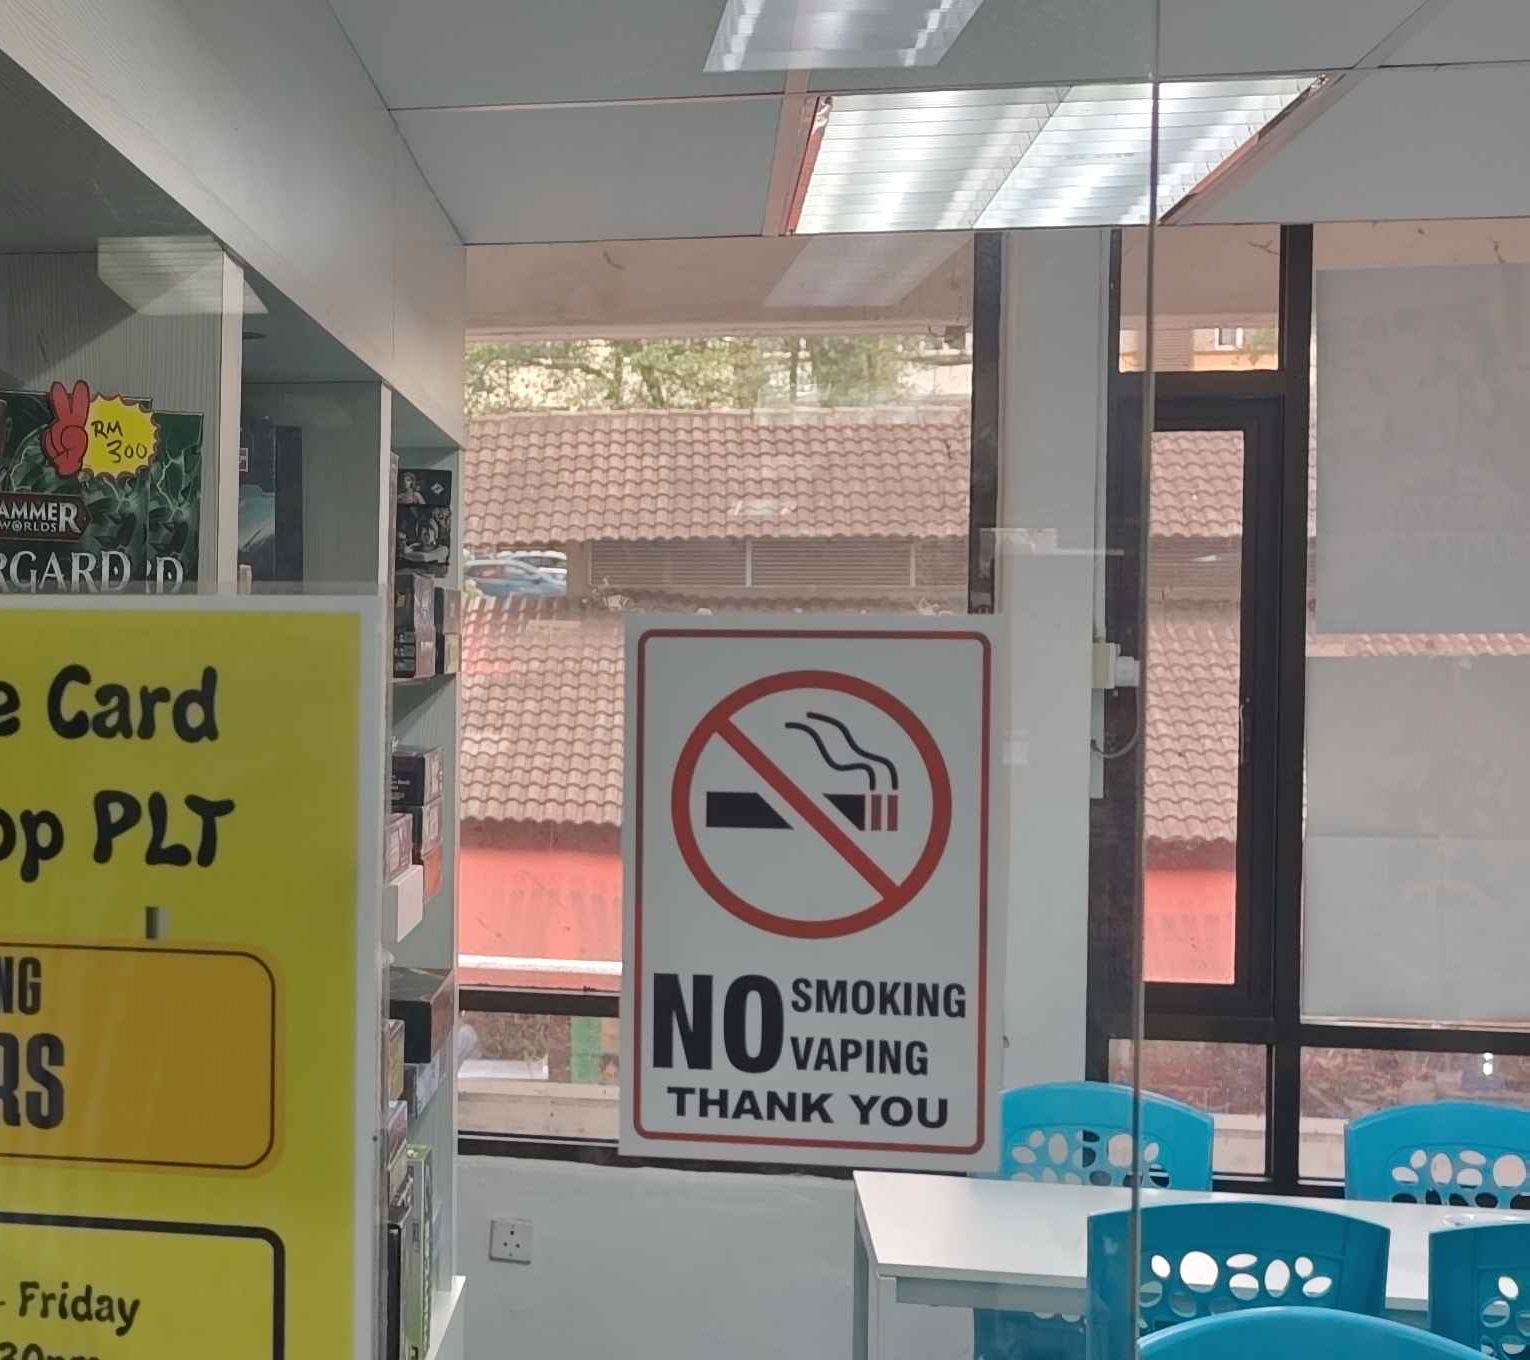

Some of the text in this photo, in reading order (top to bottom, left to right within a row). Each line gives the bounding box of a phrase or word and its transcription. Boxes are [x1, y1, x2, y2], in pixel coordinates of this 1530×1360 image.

[91, 420, 124, 439] RM
[107, 440, 148, 463] 300
[47, 665, 220, 743] Card
[93, 790, 236, 867] PLT
[791, 978, 967, 1018] SMOKING
[653, 973, 784, 1074] NO
[790, 1037, 928, 1076] VAPING
[667, 1086, 949, 1129] THANK YOU
[19, 1281, 140, 1336] Friday
